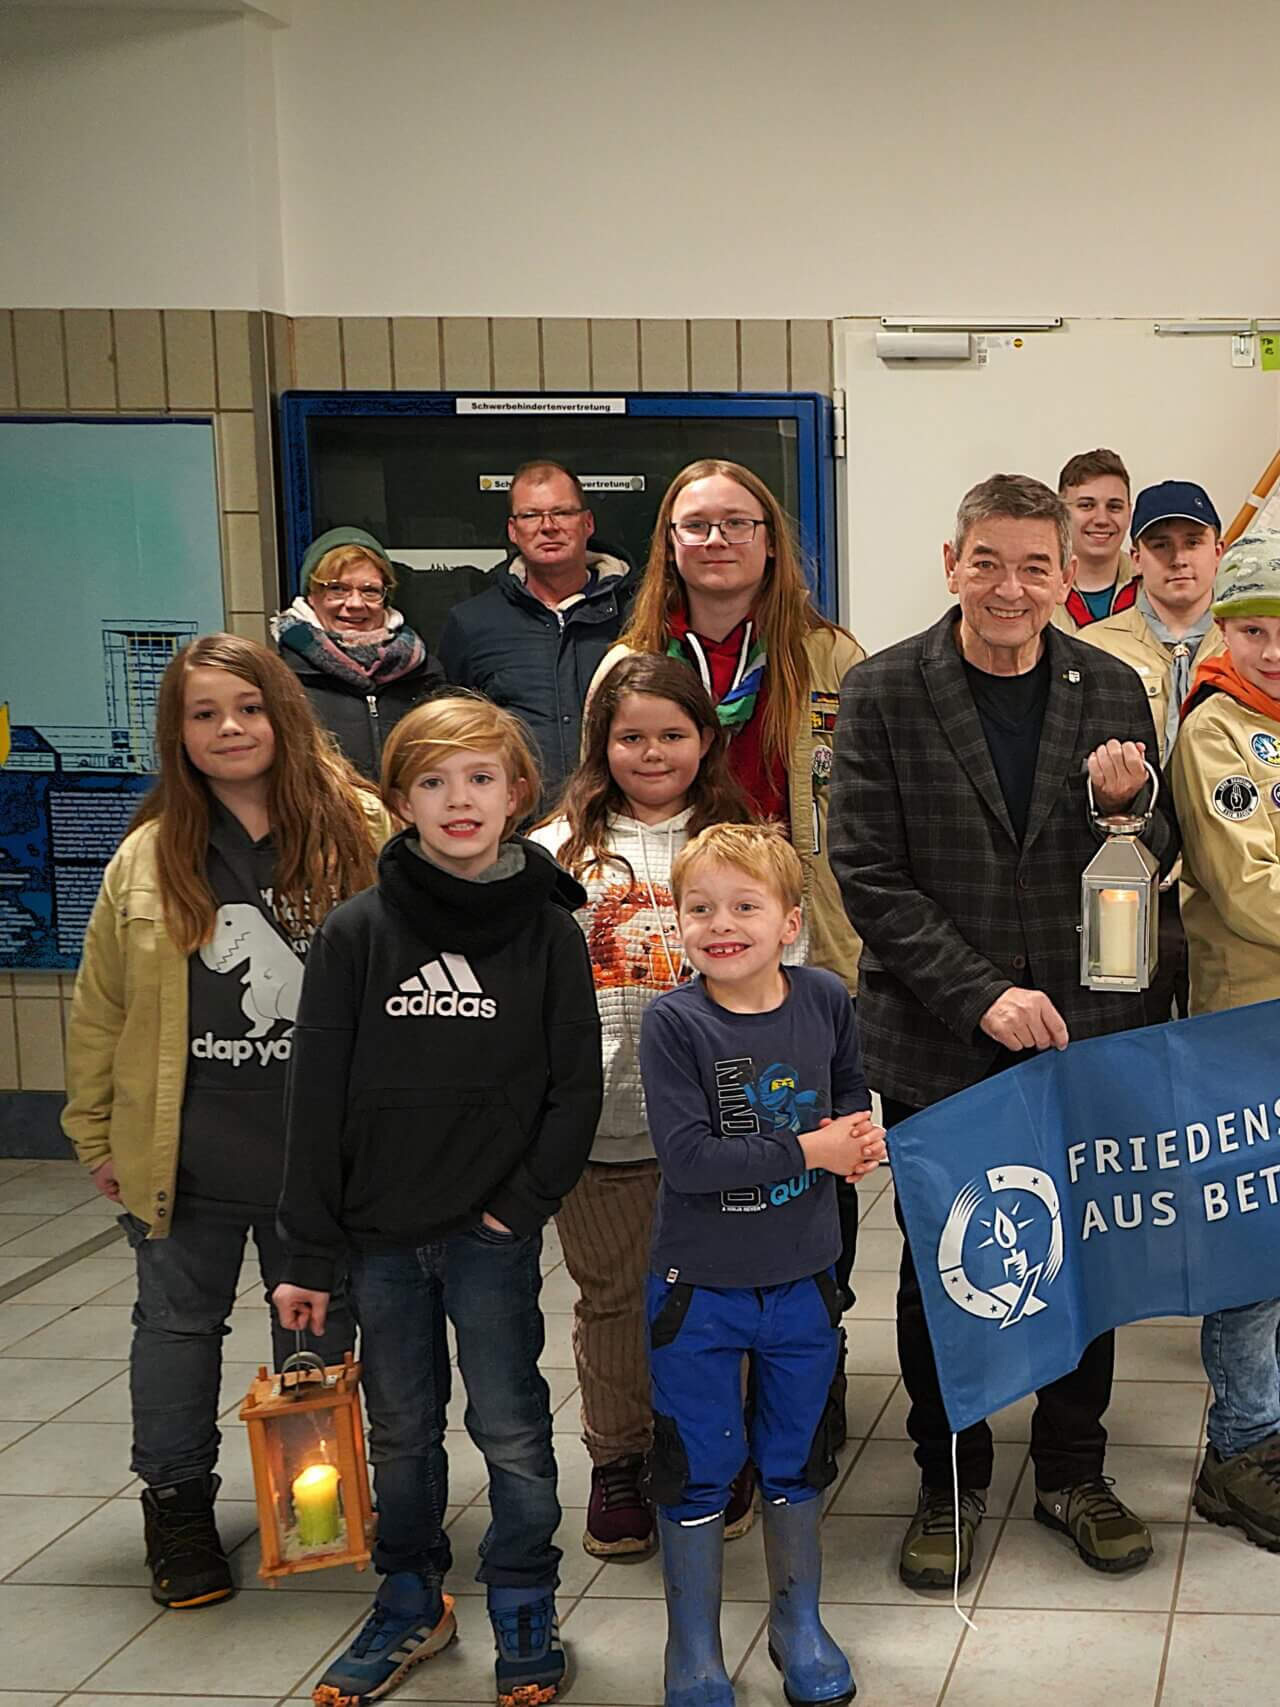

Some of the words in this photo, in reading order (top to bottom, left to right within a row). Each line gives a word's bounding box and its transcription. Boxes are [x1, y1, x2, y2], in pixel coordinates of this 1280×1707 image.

[471, 402, 611, 412] Schwerbehindertenvertretung
[385, 988, 497, 1019] adidas
[191, 1031, 254, 1067] clap
[255, 1038, 293, 1067] yo
[1081, 1191, 1177, 1241] AUS
